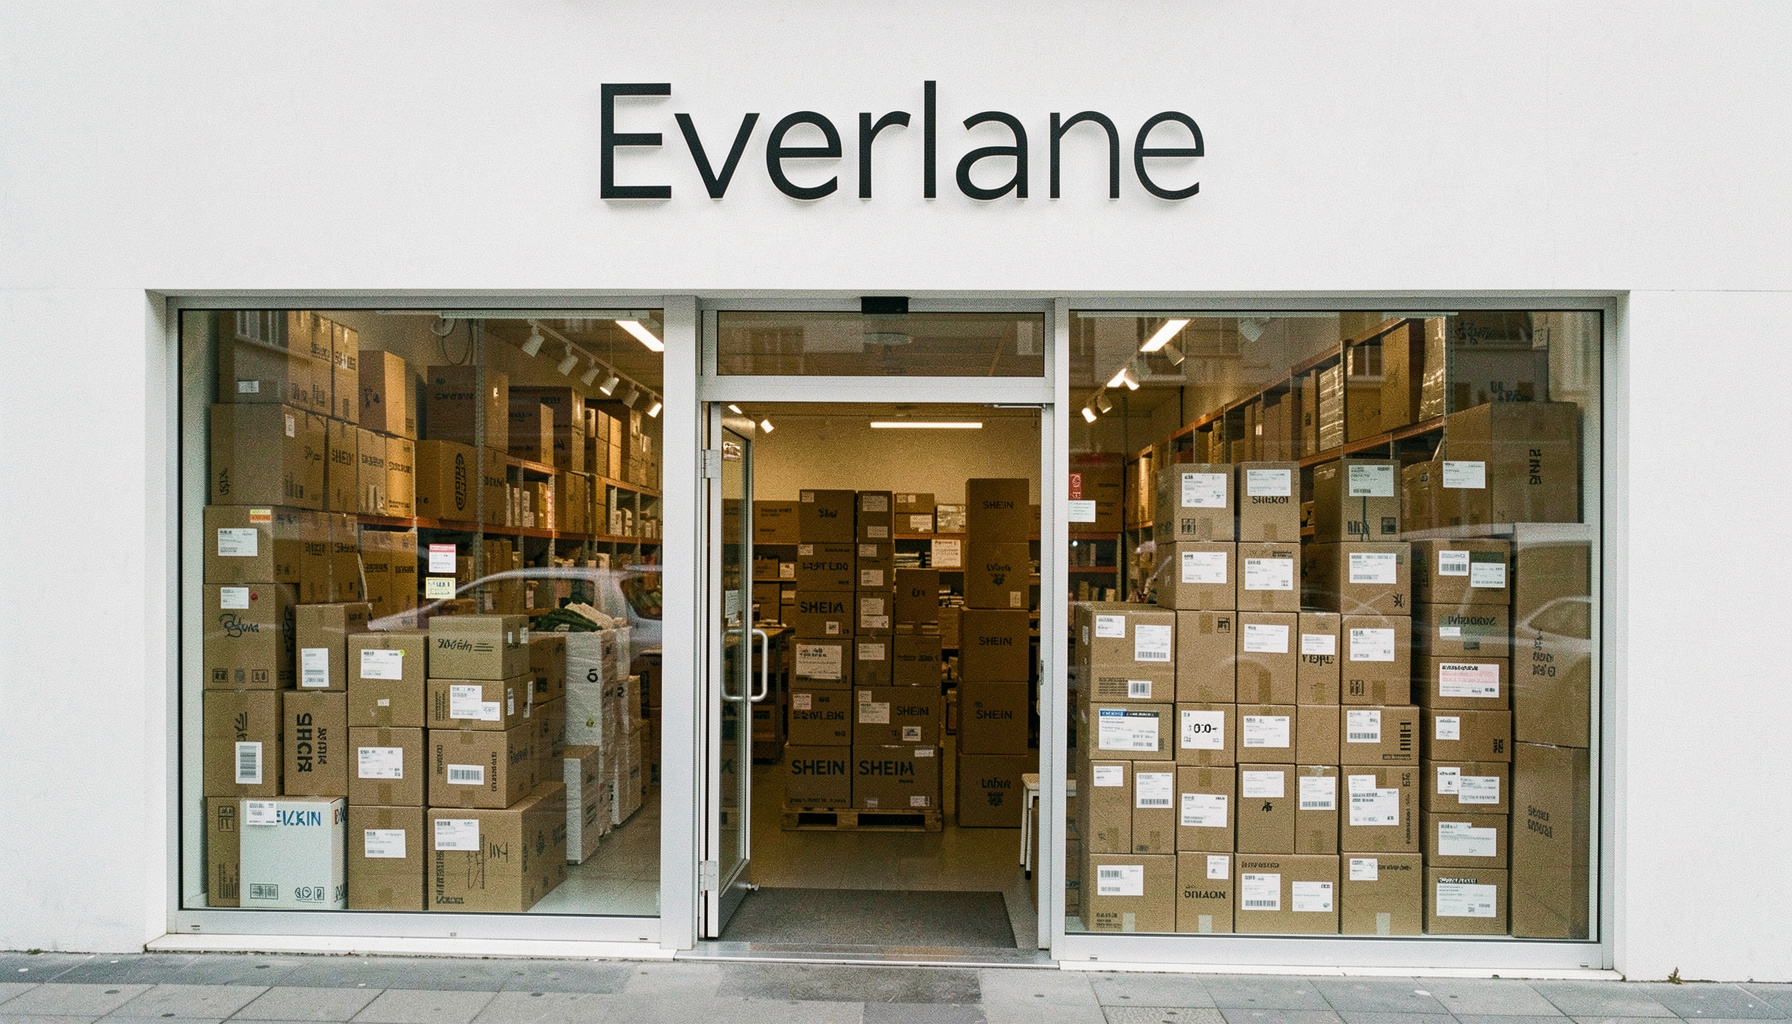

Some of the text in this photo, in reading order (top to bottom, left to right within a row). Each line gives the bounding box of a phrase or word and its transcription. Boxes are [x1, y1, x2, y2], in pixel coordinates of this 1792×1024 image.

[600, 80, 1205, 201] Everlane
[982, 500, 1014, 510] SHEIN
[978, 636, 1013, 646] SHEIN
[976, 709, 1013, 720] SHEIN
[791, 760, 845, 775] SHEIN
